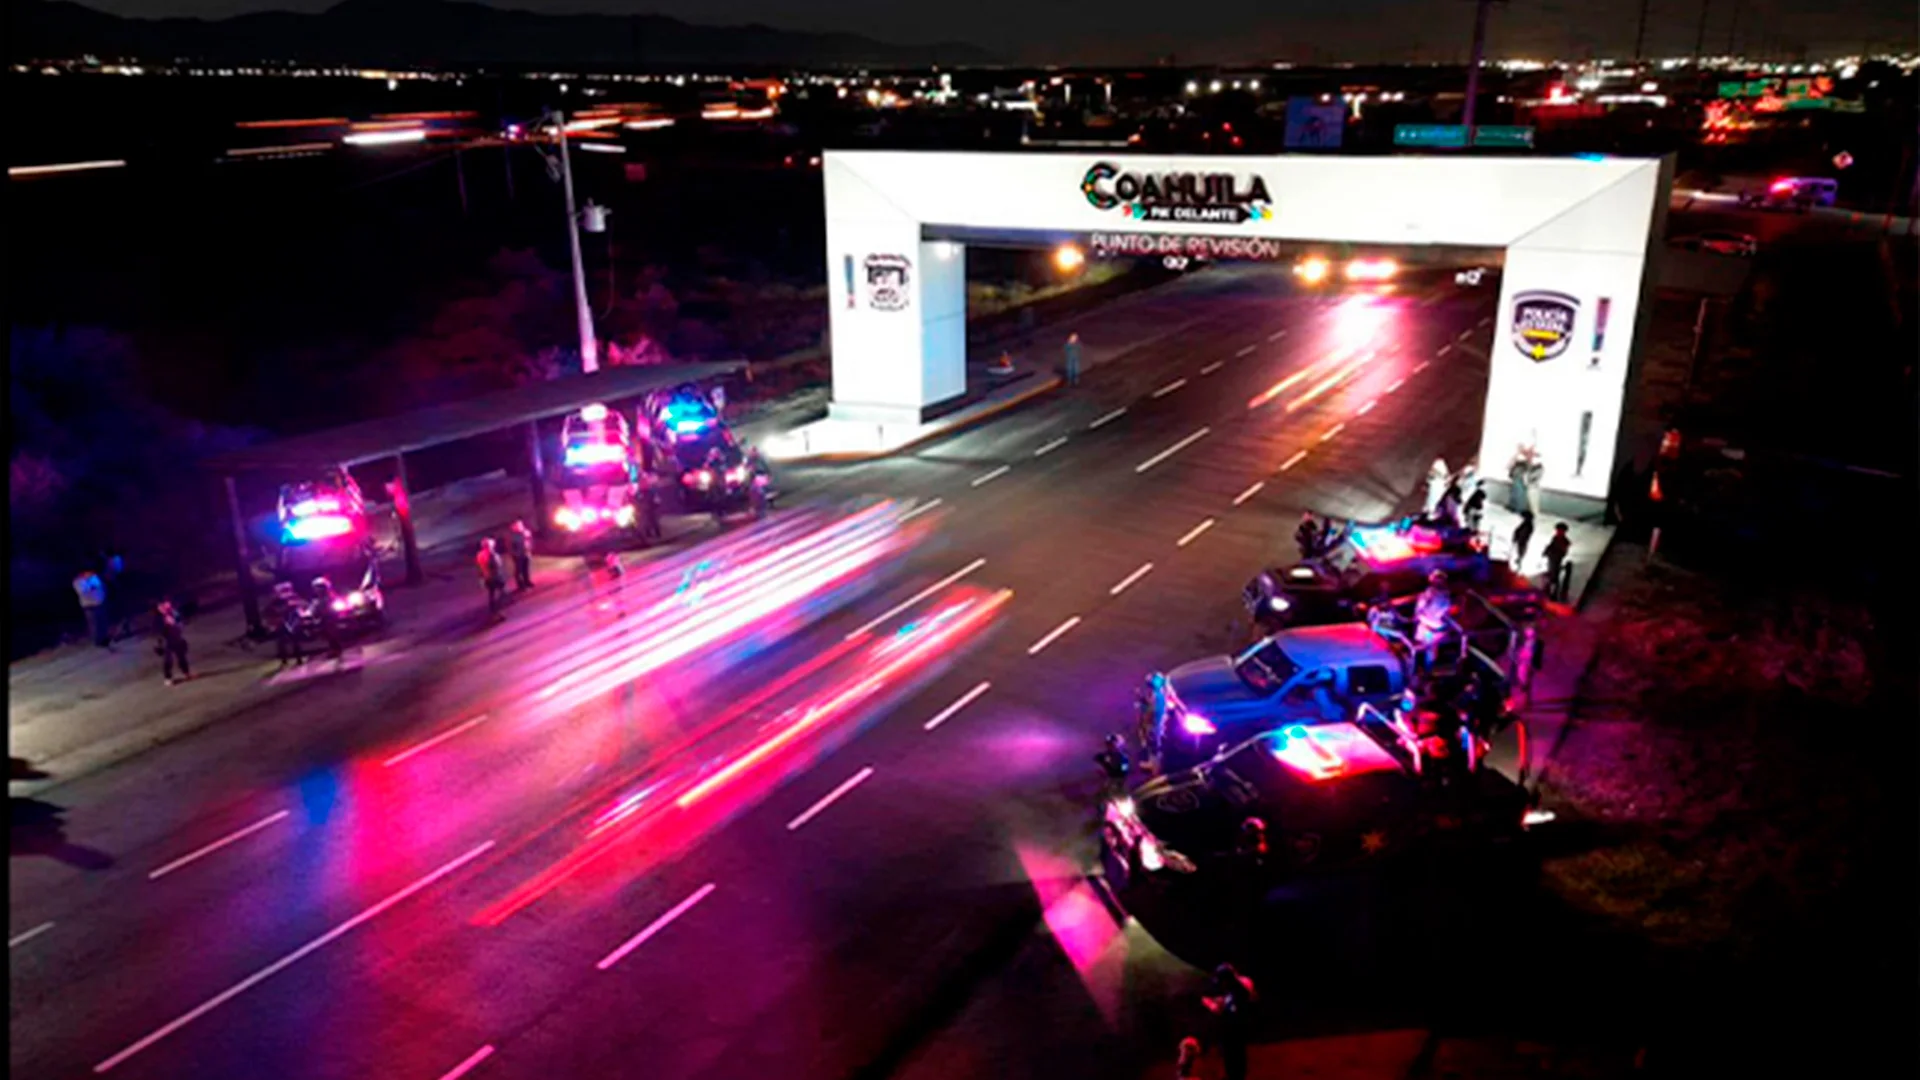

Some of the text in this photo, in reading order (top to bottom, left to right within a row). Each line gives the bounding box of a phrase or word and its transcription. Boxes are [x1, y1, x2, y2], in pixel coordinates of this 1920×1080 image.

[1081, 161, 1272, 209] COAHUILA
[1091, 232, 1279, 257] PUNTO DE REVISIÓN
